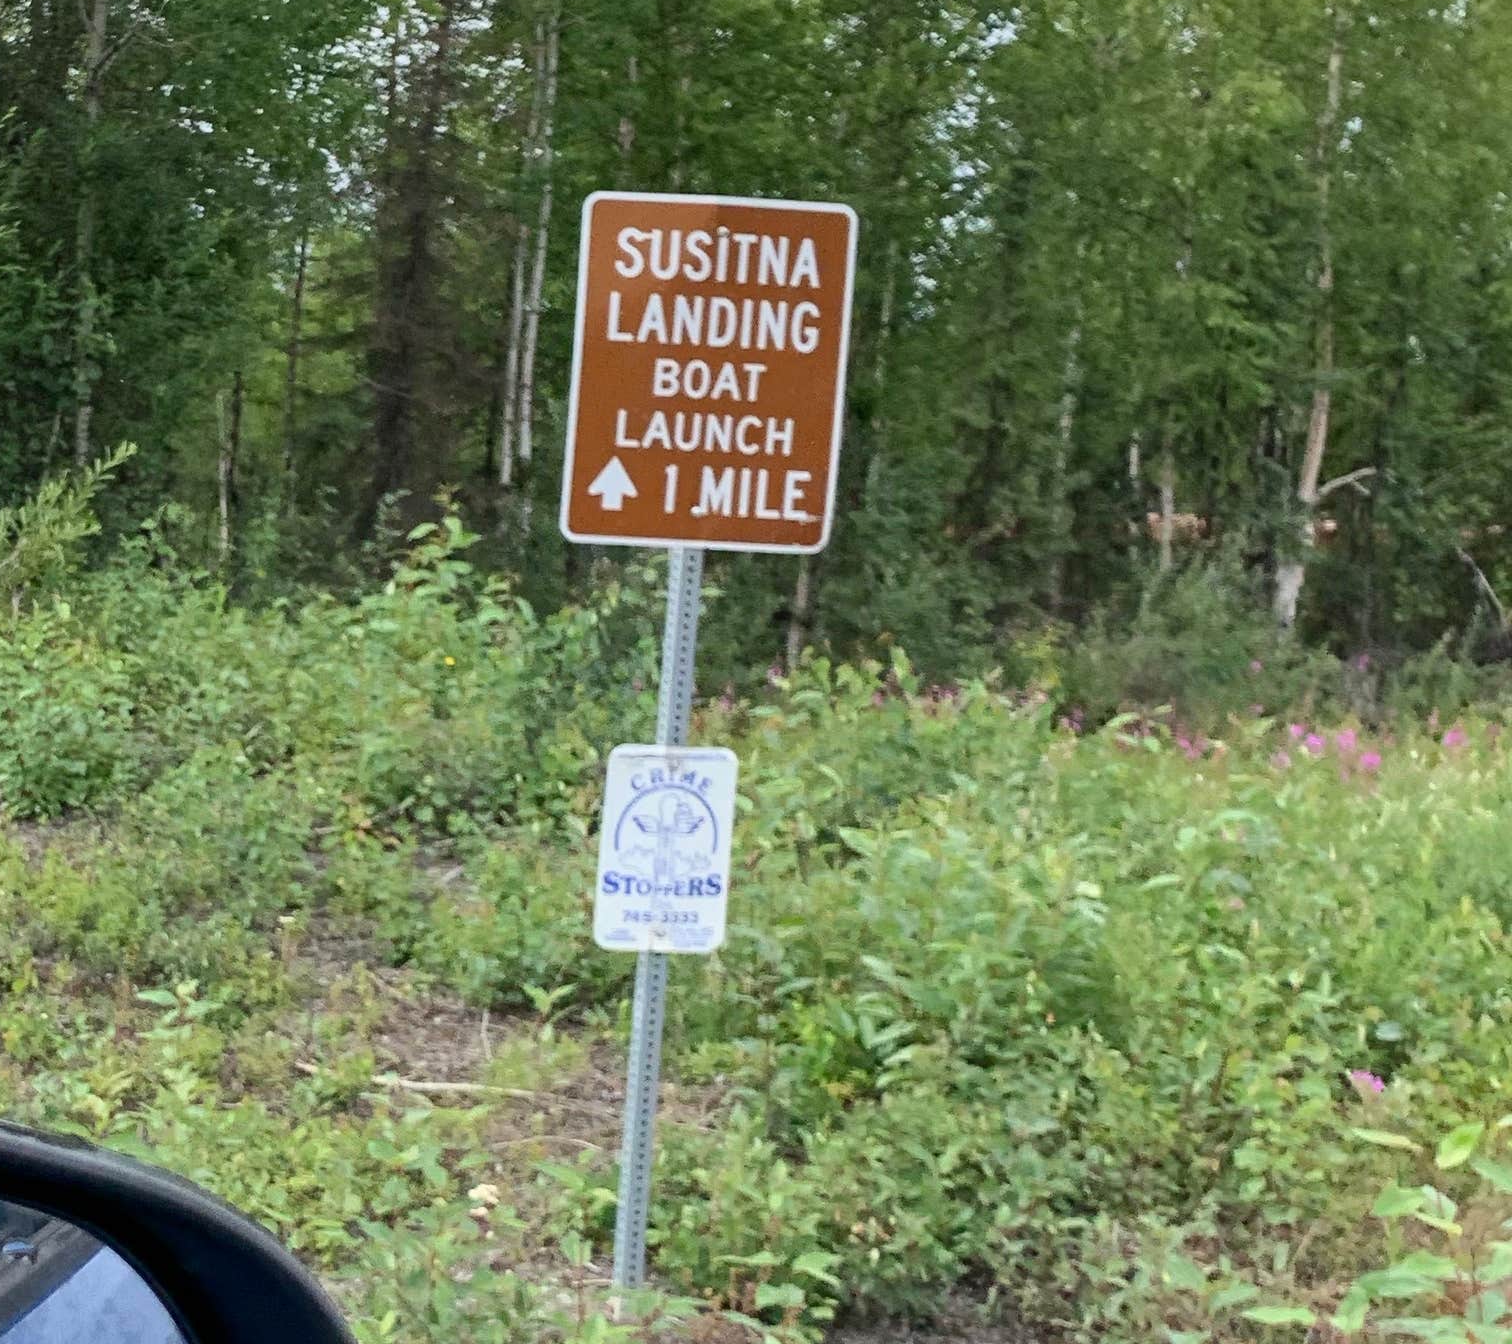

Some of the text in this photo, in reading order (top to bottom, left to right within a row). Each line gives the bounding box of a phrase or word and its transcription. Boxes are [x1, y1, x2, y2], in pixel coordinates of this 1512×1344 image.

[614, 226, 820, 288] SUSITNA
[606, 290, 820, 354] LANDING
[652, 358, 767, 402] BOAT
[614, 408, 794, 456] LAUNCH
[664, 464, 812, 522] 1 MILE
[631, 767, 713, 792] CRIME
[602, 870, 722, 897] STOPERS
